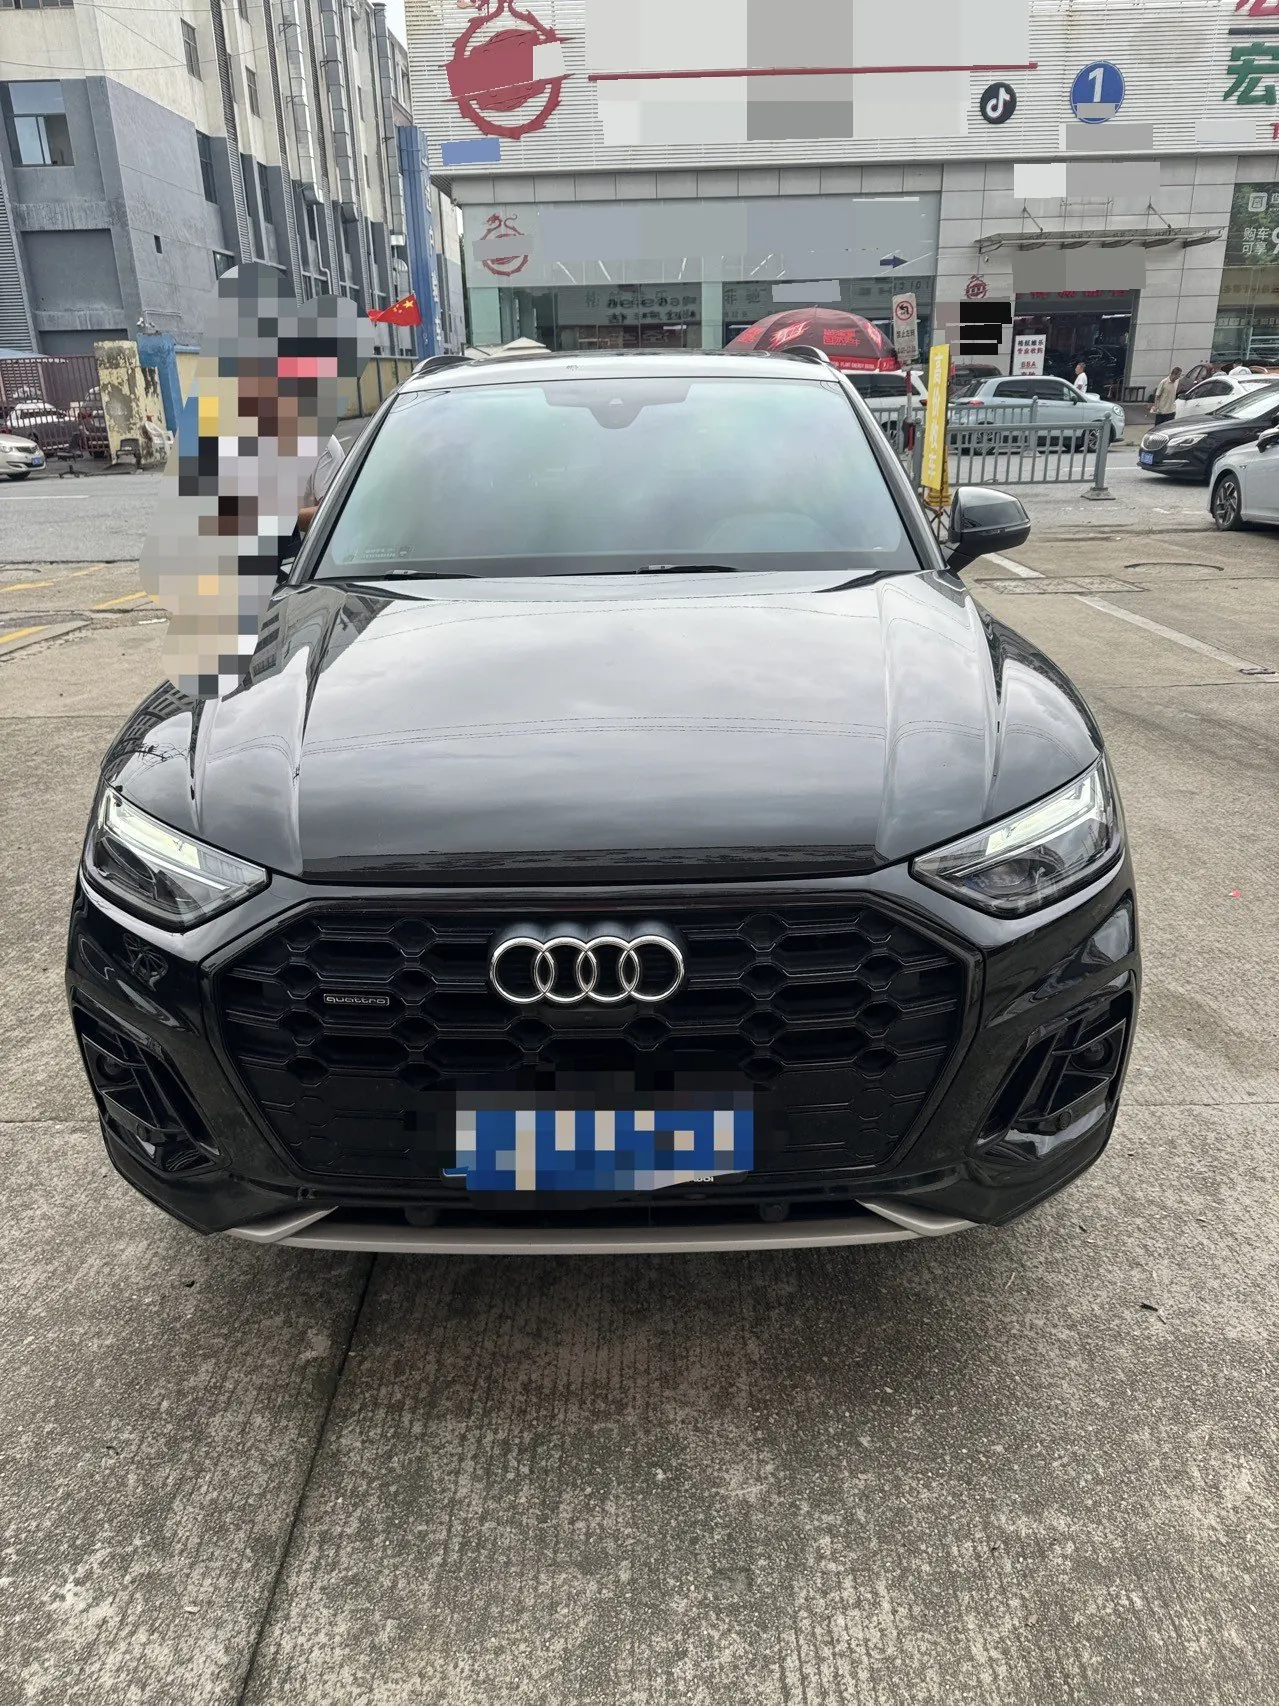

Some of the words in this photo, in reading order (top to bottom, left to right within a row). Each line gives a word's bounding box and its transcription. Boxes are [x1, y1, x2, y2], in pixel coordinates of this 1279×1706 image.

[1089, 67, 1105, 103] 1
[1242, 227, 1270, 241] 购车
[1242, 241, 1268, 255] 可享
[928, 353, 945, 480] 高价收车
[326, 996, 386, 1004] quattro
